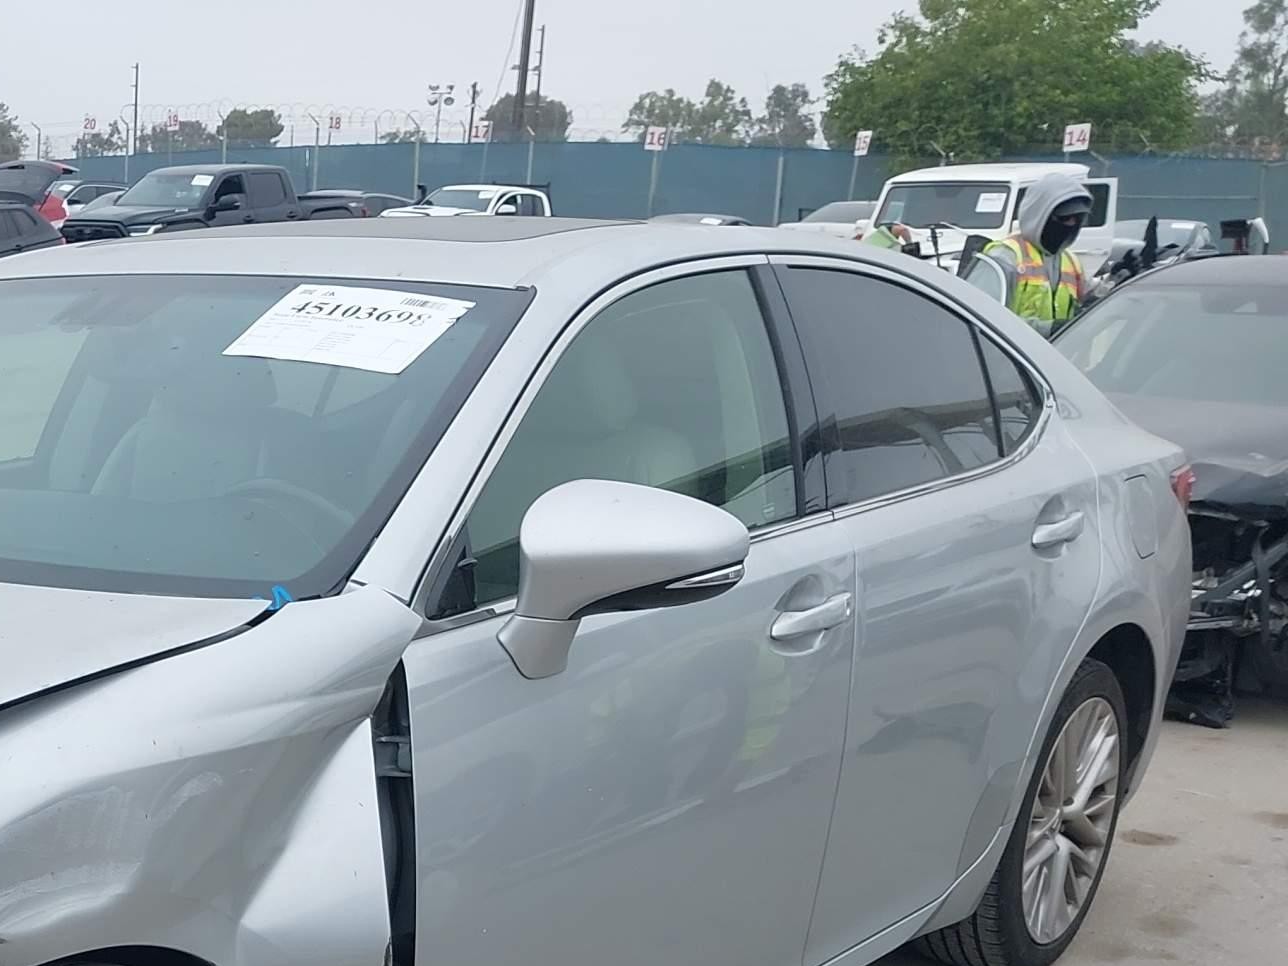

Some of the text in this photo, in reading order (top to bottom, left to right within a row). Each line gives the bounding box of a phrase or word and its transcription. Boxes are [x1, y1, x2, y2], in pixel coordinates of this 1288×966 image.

[83, 118, 97, 130] 20
[167, 114, 179, 127] 19
[328, 116, 342, 129] 18
[472, 125, 490, 138] 17
[1066, 129, 1087, 146] 14
[647, 132, 665, 145] 16
[857, 136, 870, 150] 15
[291, 301, 432, 327] 45103698
